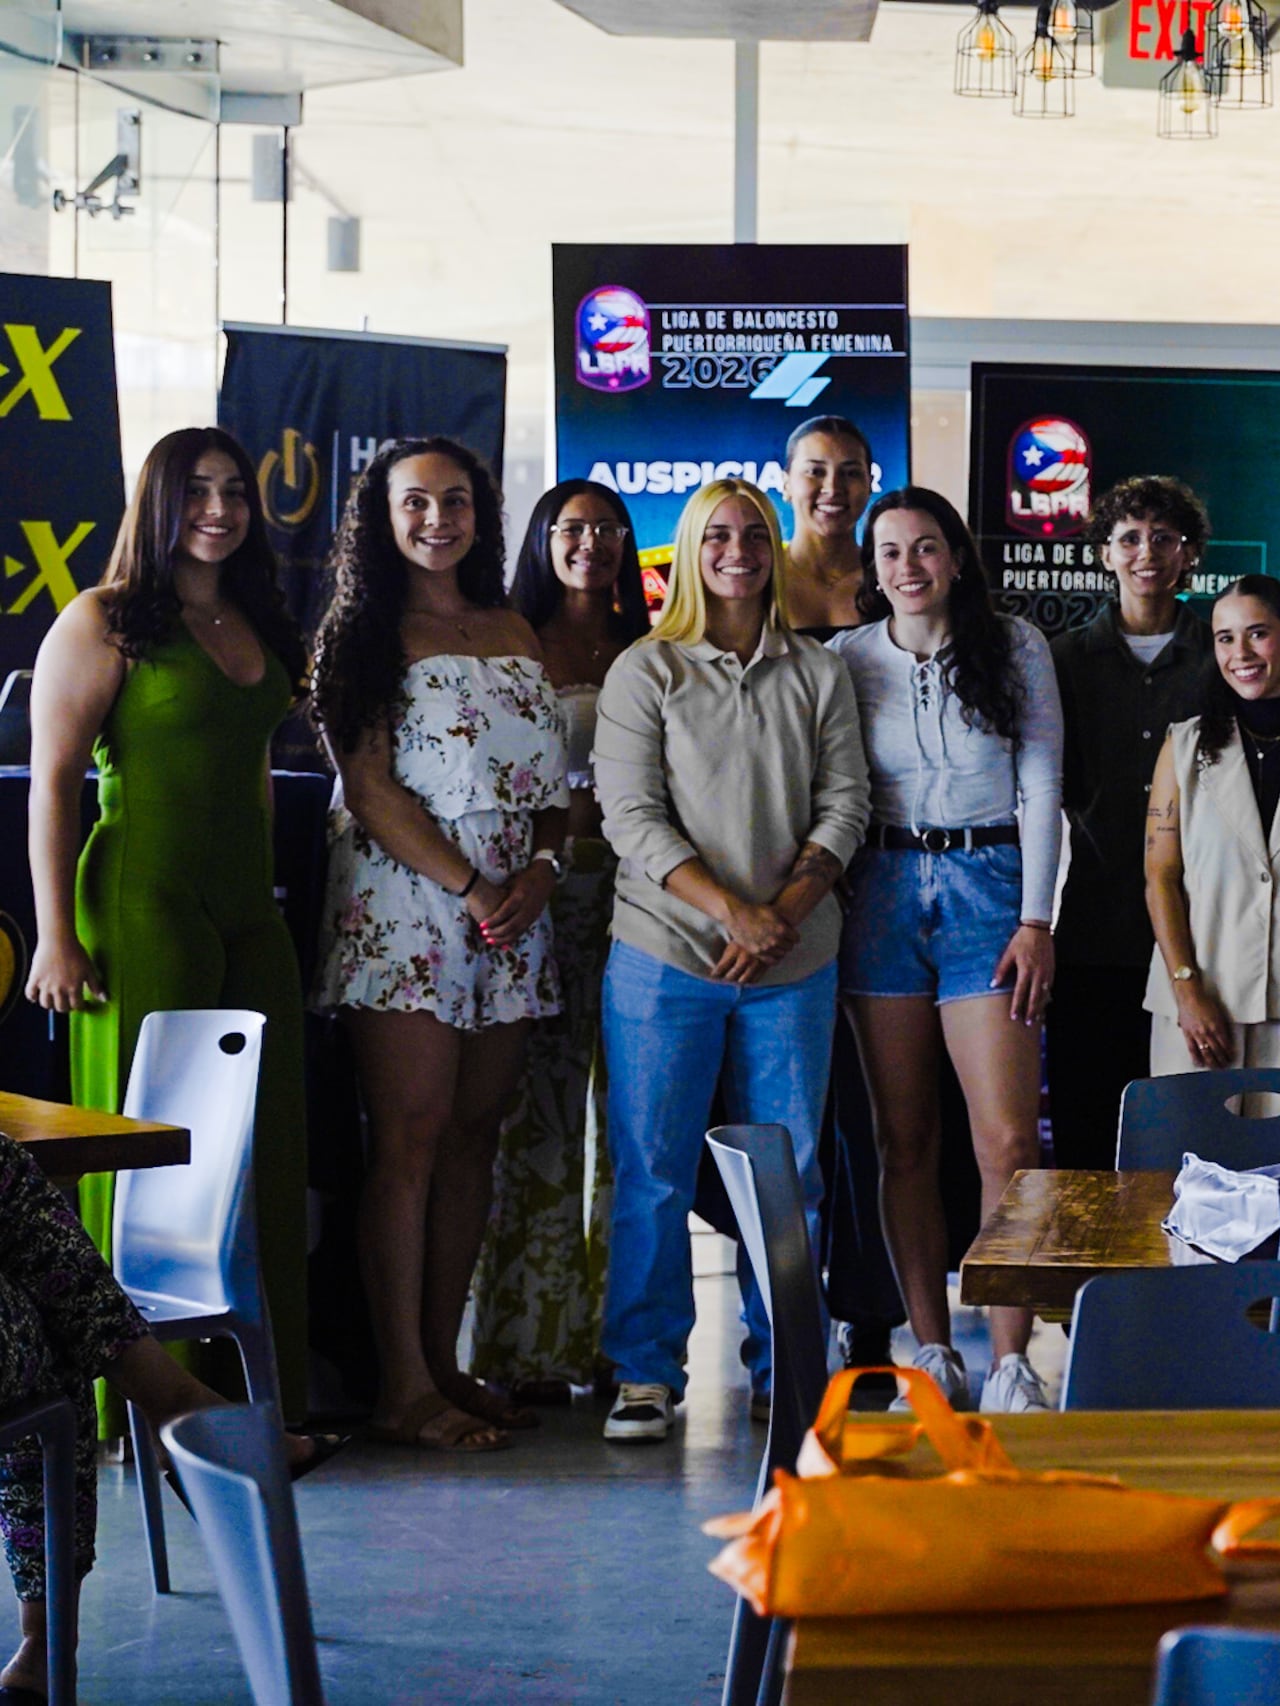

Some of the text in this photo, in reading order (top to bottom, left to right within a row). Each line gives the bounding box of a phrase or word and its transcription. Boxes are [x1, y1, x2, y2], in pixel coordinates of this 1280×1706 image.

[1129, 0, 1214, 64] EXIT
[662, 310, 839, 330] LIGA DE BALONCESTO
[661, 331, 894, 352] PUERTORRIQUEÑA FEMENINA
[661, 352, 778, 389] 2026
[1003, 543, 1046, 564] LIGA
[1053, 544, 1076, 566] DE
